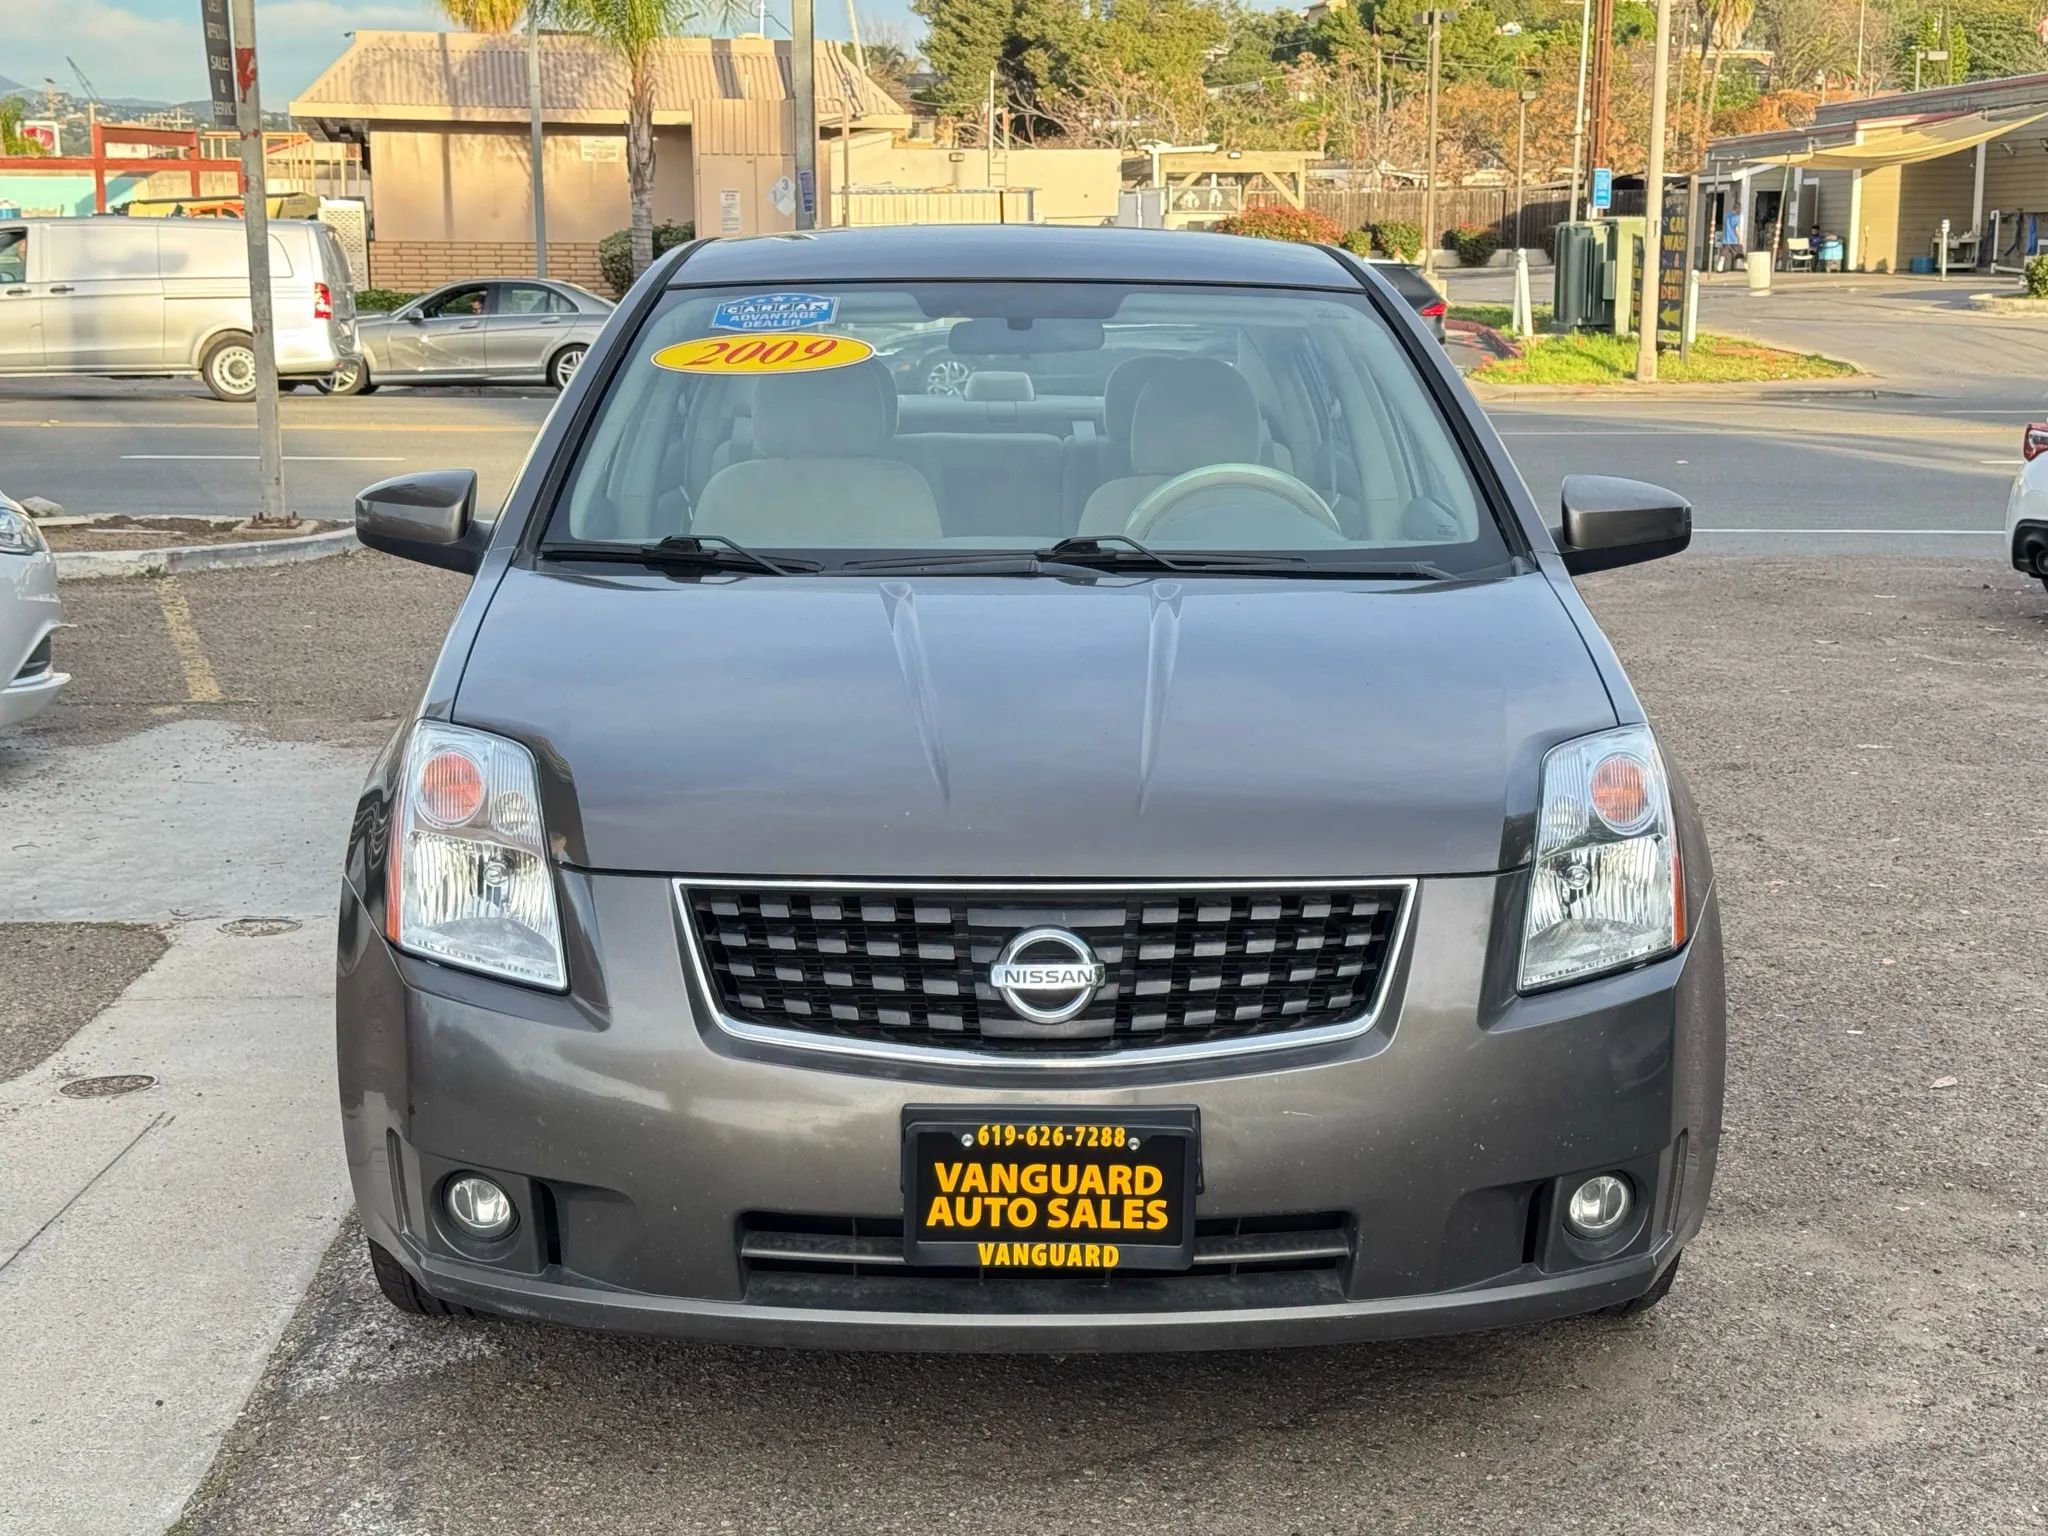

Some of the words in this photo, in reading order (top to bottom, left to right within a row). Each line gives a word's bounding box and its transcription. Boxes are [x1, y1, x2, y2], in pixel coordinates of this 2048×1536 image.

[725, 301, 829, 314] CARFAX
[730, 311, 818, 322] ADVANTAGE
[742, 319, 801, 329] DEALER
[683, 339, 838, 366] 2009
[1004, 970, 1093, 984] NISSAN
[977, 1124, 1126, 1148] 619-626-7288
[933, 1162, 1163, 1196] VANGUARD
[926, 1196, 1038, 1227] AUTO
[1047, 1198, 1169, 1230] SALES
[977, 1242, 1120, 1268] VANGUARD
